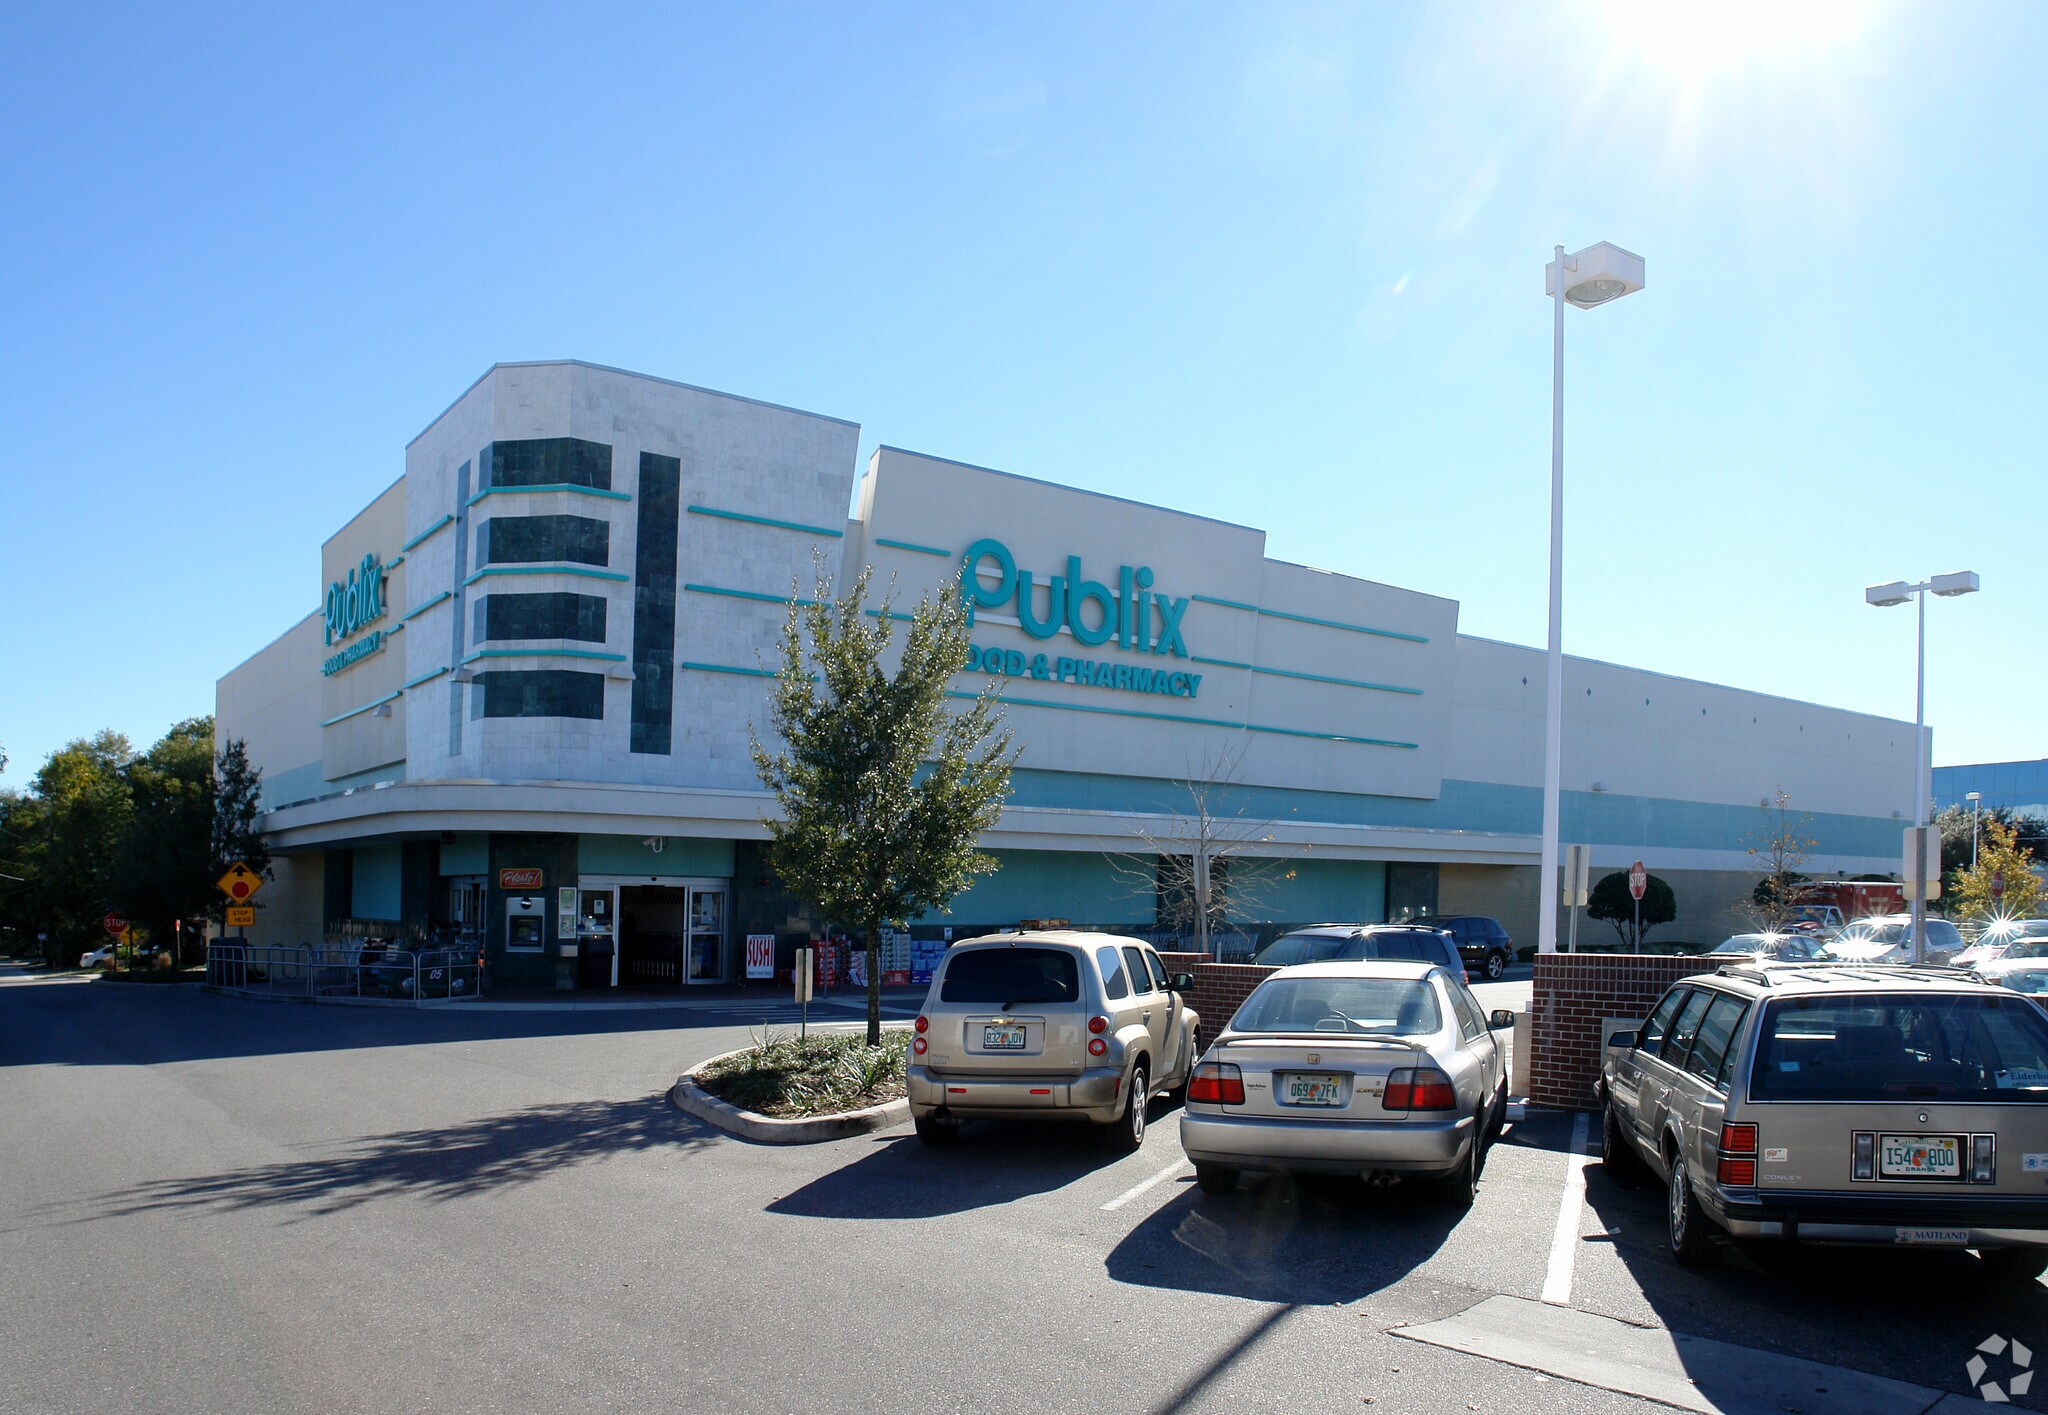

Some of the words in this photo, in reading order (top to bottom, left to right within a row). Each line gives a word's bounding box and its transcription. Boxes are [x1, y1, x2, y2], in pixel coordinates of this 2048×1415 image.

[325, 553, 382, 647] Publix
[961, 538, 1189, 659] Publix
[965, 643, 1026, 677] OOD
[1031, 653, 1051, 681] &
[1057, 656, 1202, 698] PHARMACY
[502, 871, 540, 885] Presto!
[1630, 872, 1645, 888] STOP
[105, 918, 127, 927] STOP
[748, 939, 774, 967] SUSHI
[430, 969, 442, 980] 05
[986, 1032, 1000, 1043] 832
[1320, 1084, 1338, 1098] 7FK
[1886, 1148, 1912, 1165] I54
[1914, 1231, 1967, 1240] MAITLAND
